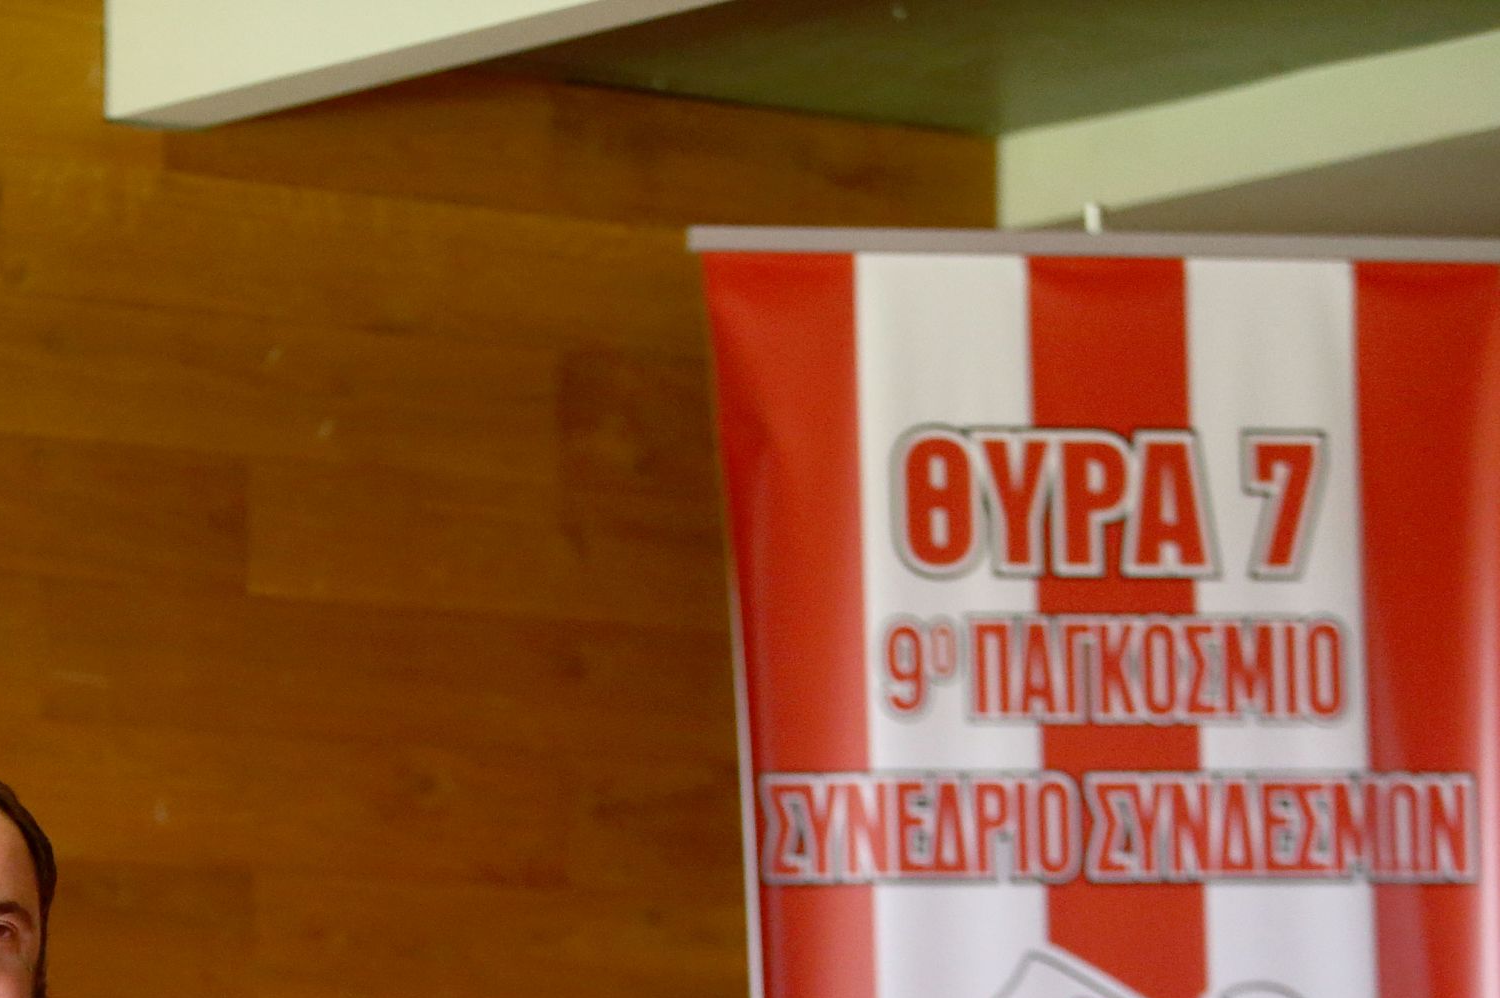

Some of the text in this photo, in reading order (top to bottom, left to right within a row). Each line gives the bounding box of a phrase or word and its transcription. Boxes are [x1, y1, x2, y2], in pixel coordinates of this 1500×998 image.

[894, 426, 1328, 578] ΘΥΡΑ 7
[967, 618, 1347, 722] ΠΑΓΚΟΣΜΙΟ
[763, 774, 1477, 882] ΣΥΝΕΔΡΙΟ ΣΥΝΔΕΣΜΩΝ
